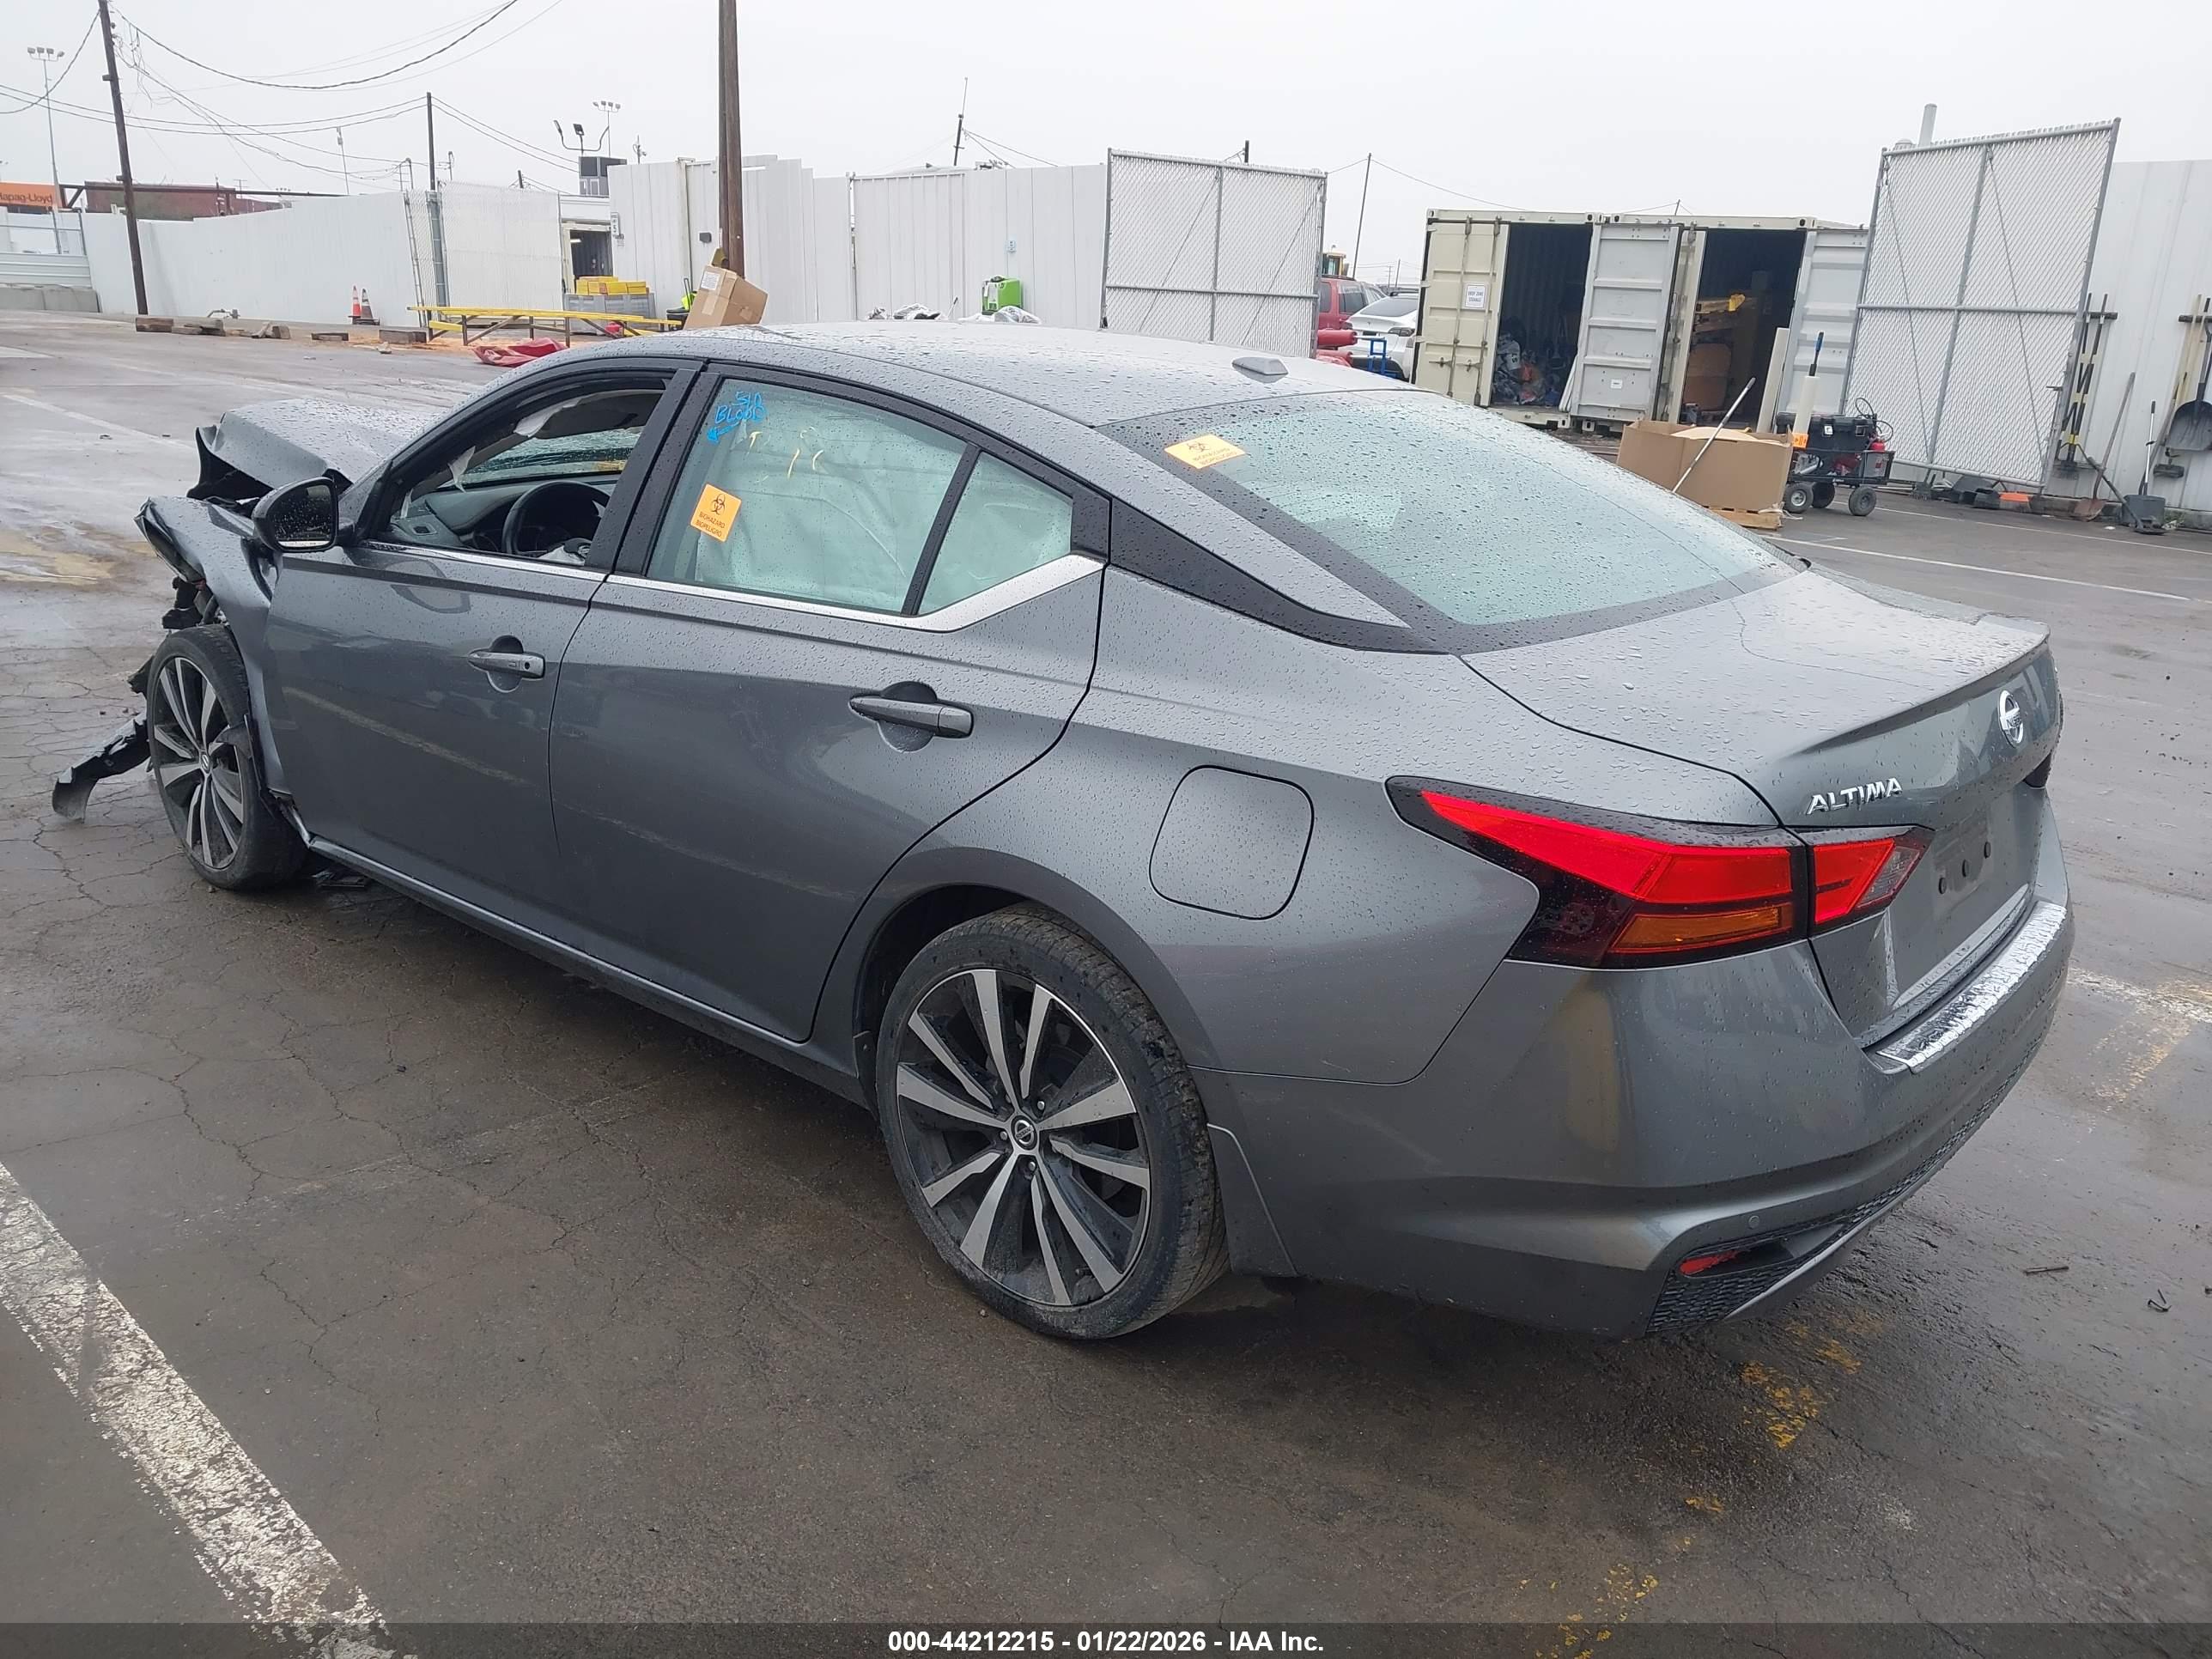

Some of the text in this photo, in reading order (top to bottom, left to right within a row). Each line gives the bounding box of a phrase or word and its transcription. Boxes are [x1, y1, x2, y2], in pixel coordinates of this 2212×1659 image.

[696, 520, 722, 538] BIOPELIGRO
[699, 511, 726, 529] BIOHAZARD
[1806, 777, 1903, 816] ALTIMA
